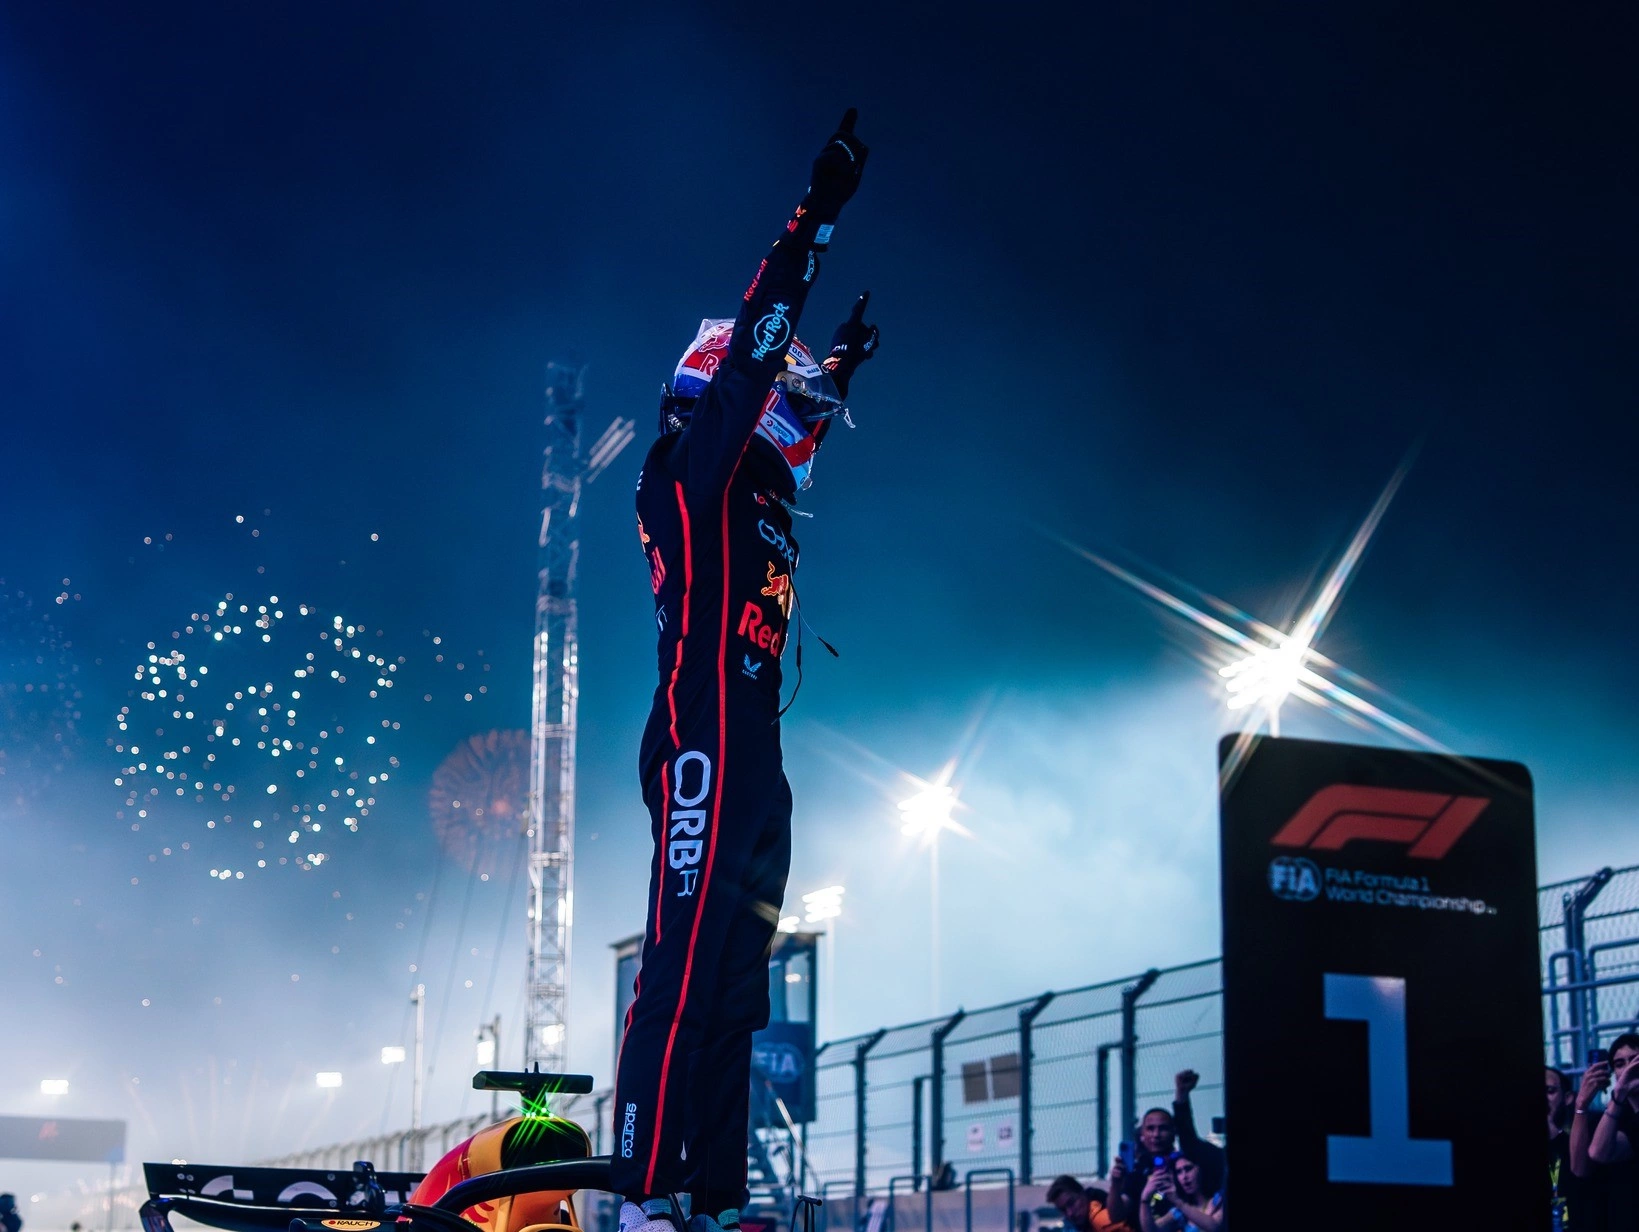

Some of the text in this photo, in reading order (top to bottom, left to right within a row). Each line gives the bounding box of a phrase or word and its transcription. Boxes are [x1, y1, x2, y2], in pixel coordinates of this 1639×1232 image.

[752, 301, 789, 361] Hard Rock
[737, 601, 780, 657] Red
[1270, 863, 1317, 893] FIA
[1324, 867, 1430, 892] FIA Formula 1
[1325, 886, 1374, 905] World
[1324, 974, 1453, 1186] 1
[621, 1102, 637, 1159] sparco
[336, 1219, 374, 1227] RAUCH
